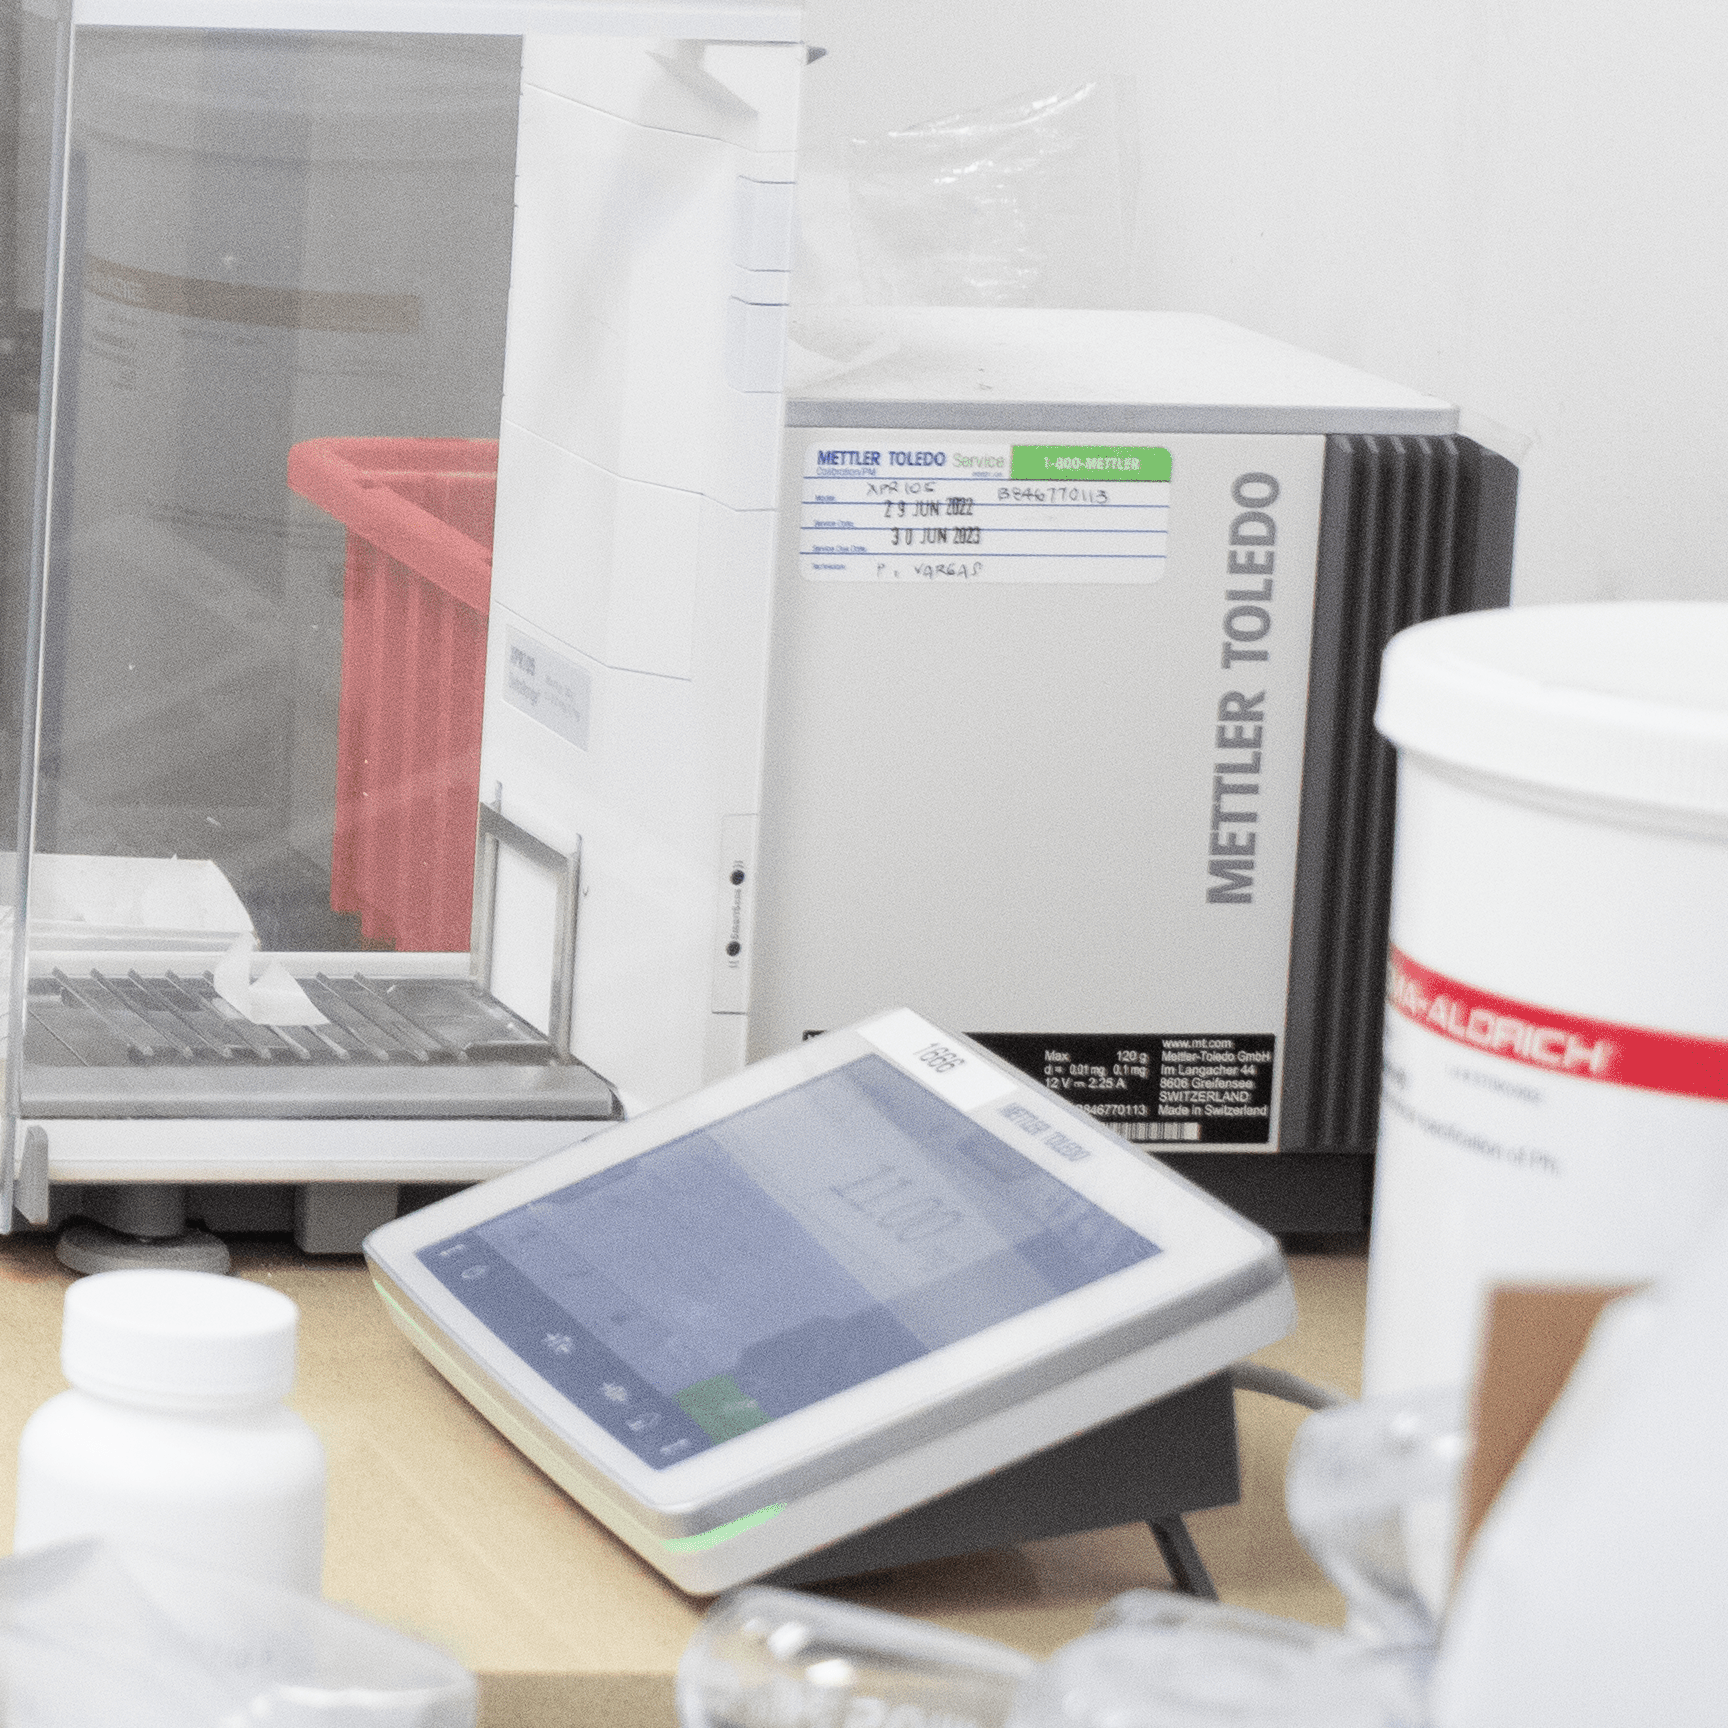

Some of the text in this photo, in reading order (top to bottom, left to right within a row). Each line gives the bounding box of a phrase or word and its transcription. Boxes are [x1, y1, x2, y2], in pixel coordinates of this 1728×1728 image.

[817, 450, 1005, 468] METTLER TOLEDO Service
[1043, 456, 1142, 471] 1-800-METTLER
[913, 500, 939, 517] JUN
[920, 527, 947, 544] JUN
[1205, 471, 1280, 904] METTLER TOLEDO
[1162, 1037, 1234, 1049] www.mt.com
[1044, 1049, 1149, 1064] Max 120 g
[1161, 1050, 1271, 1063] Mettler-Toledo GmbH
[1161, 1064, 1256, 1078] Im Langacher 44
[1046, 1077, 1127, 1089] 12 V 2.25 A
[1160, 1077, 1255, 1089] 8606 Greifensee
[1159, 1090, 1251, 1103] SWITZERLAND
[1158, 1104, 1268, 1117] Made in Switzerland
